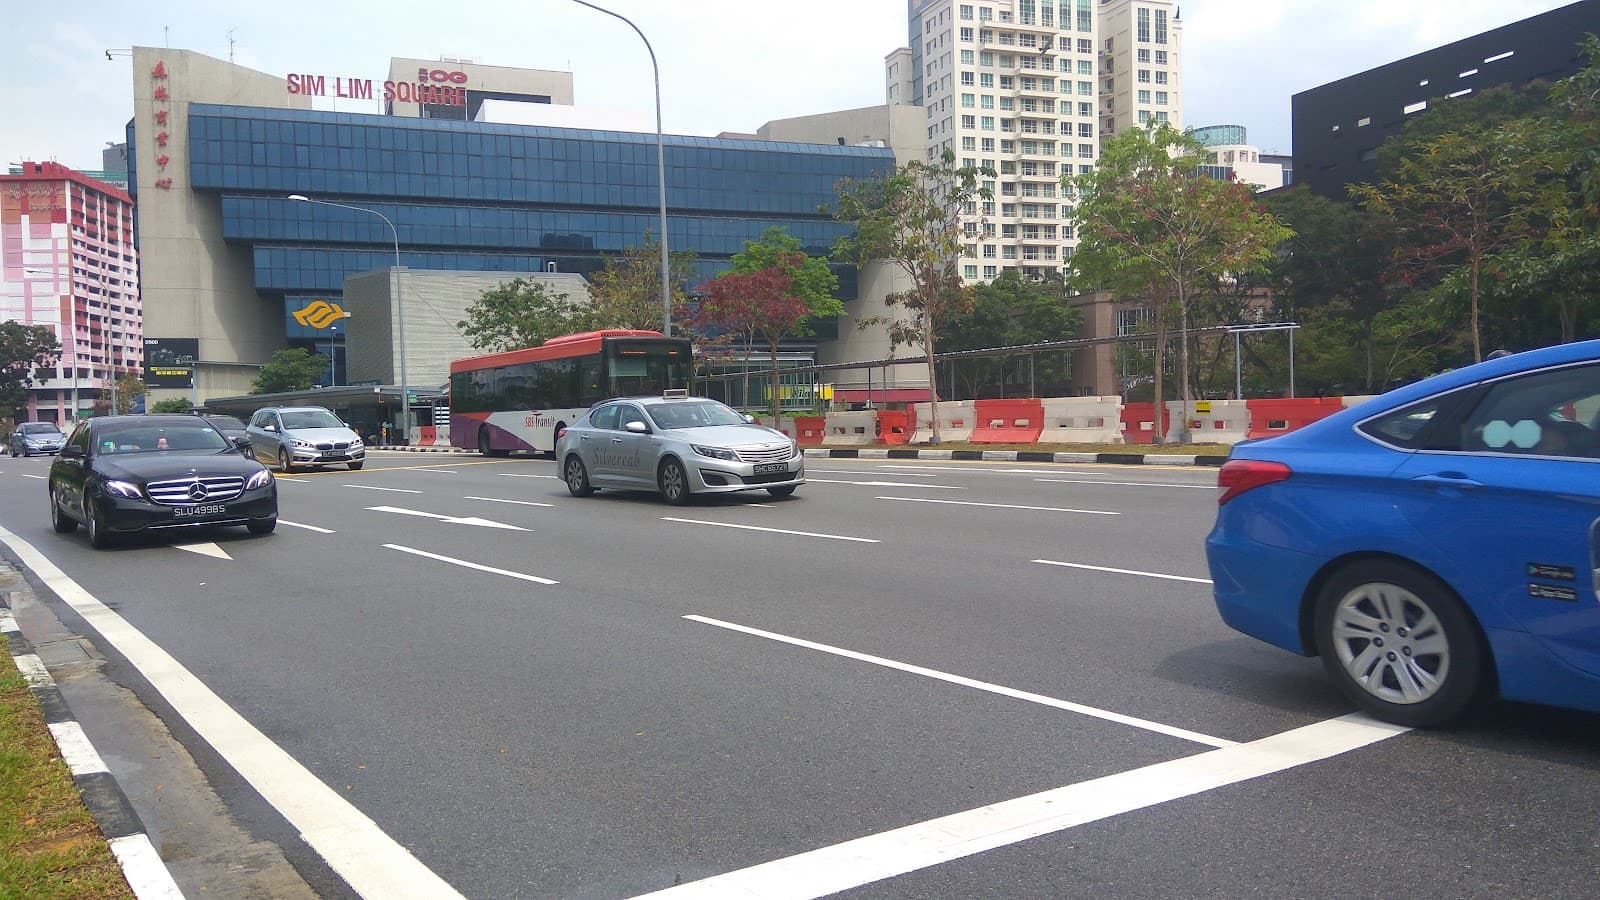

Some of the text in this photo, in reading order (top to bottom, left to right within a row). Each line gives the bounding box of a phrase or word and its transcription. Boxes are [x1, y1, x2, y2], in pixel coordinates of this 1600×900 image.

[429, 69, 468, 84] OG
[287, 73, 466, 107] SIM LIM SQUARE
[525, 413, 555, 429] SBS Transit
[593, 447, 640, 467] Silvercab
